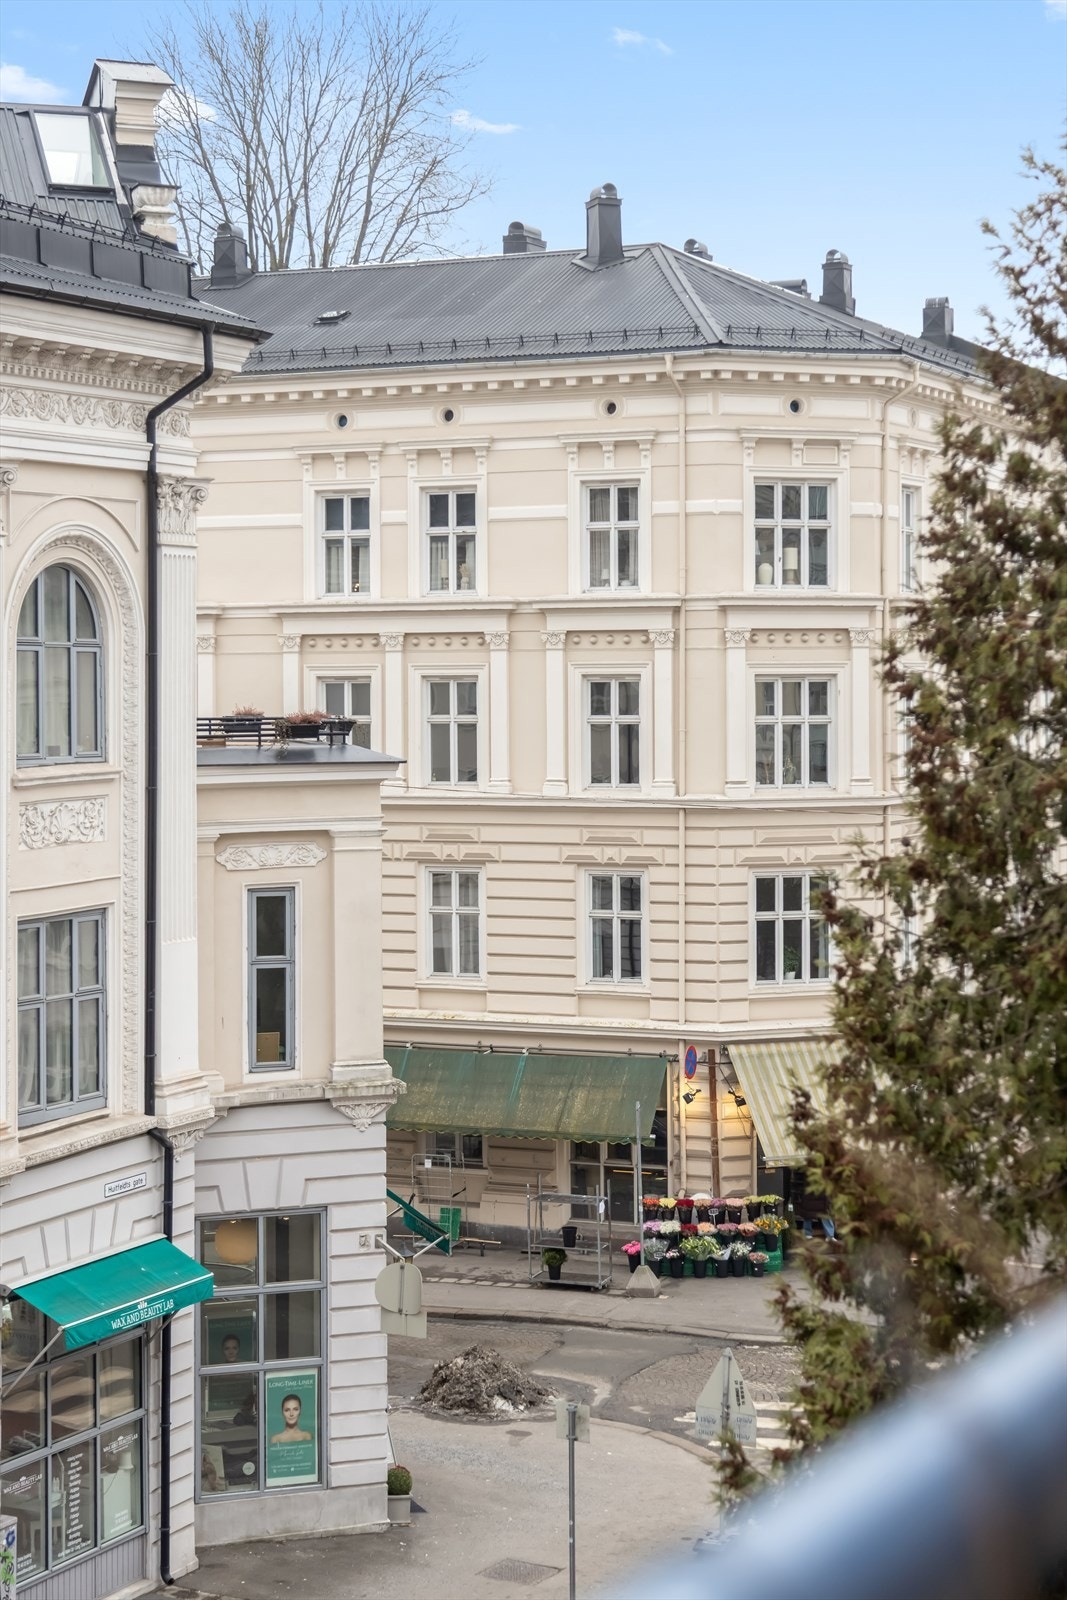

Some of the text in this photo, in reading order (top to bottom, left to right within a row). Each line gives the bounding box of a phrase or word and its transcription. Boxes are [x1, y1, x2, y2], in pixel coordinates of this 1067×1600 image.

[133, 1178, 143, 1188] gate
[111, 1299, 174, 1329] WAX AND BEAUTY LAB
